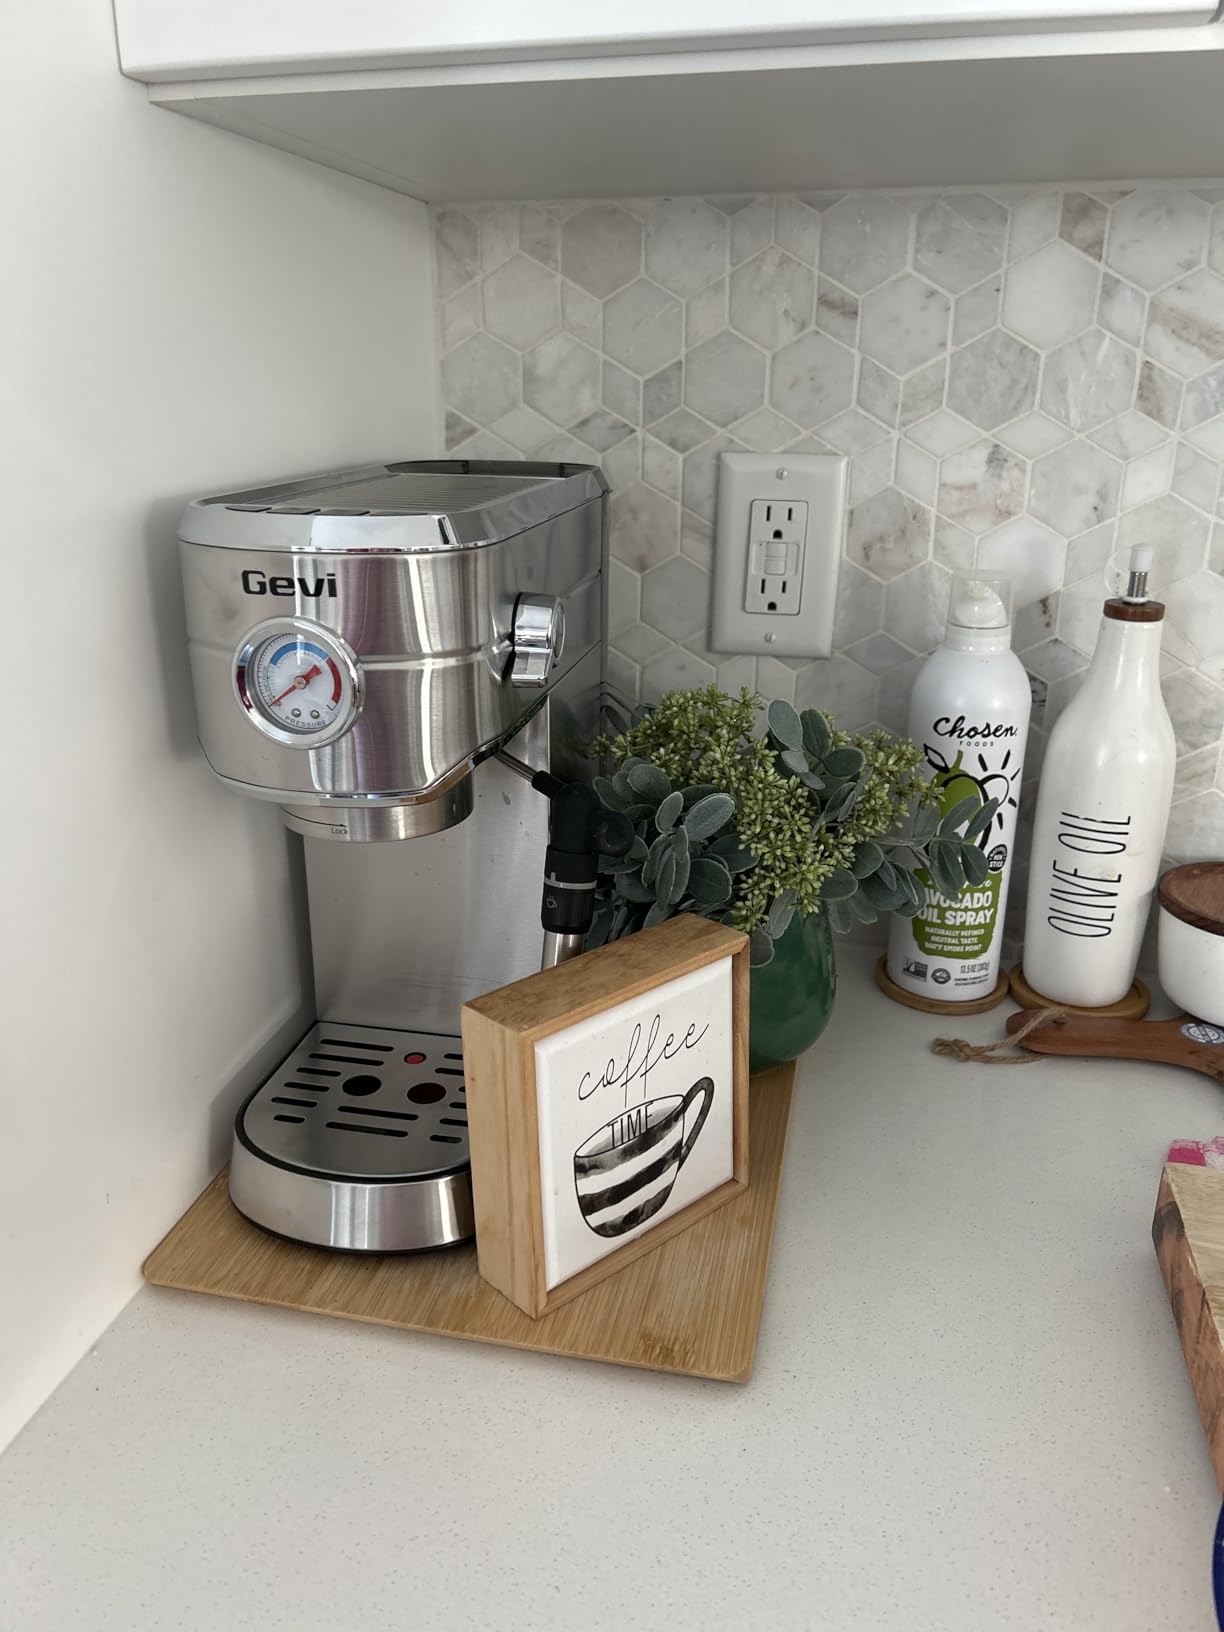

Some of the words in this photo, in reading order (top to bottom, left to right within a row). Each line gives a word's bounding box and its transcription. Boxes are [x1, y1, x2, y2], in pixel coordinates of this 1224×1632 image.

[241, 570, 338, 598] Gevi
[285, 715, 328, 729] PRESSURE
[933, 715, 1015, 738] Chosen
[331, 826, 347, 835] Lock
[1058, 811, 1131, 854] OIL
[1048, 859, 1122, 937] OLIVE
[918, 907, 942, 923] OIL
[944, 908, 994, 926] SPRAY
[925, 926, 961, 937] NATURALLY
[930, 935, 959, 945] NEUTRAL
[944, 944, 965, 952] SMOKE
[965, 944, 982, 952] POINT
[578, 1014, 710, 1108] coffee
[607, 1101, 654, 1149] TIME
